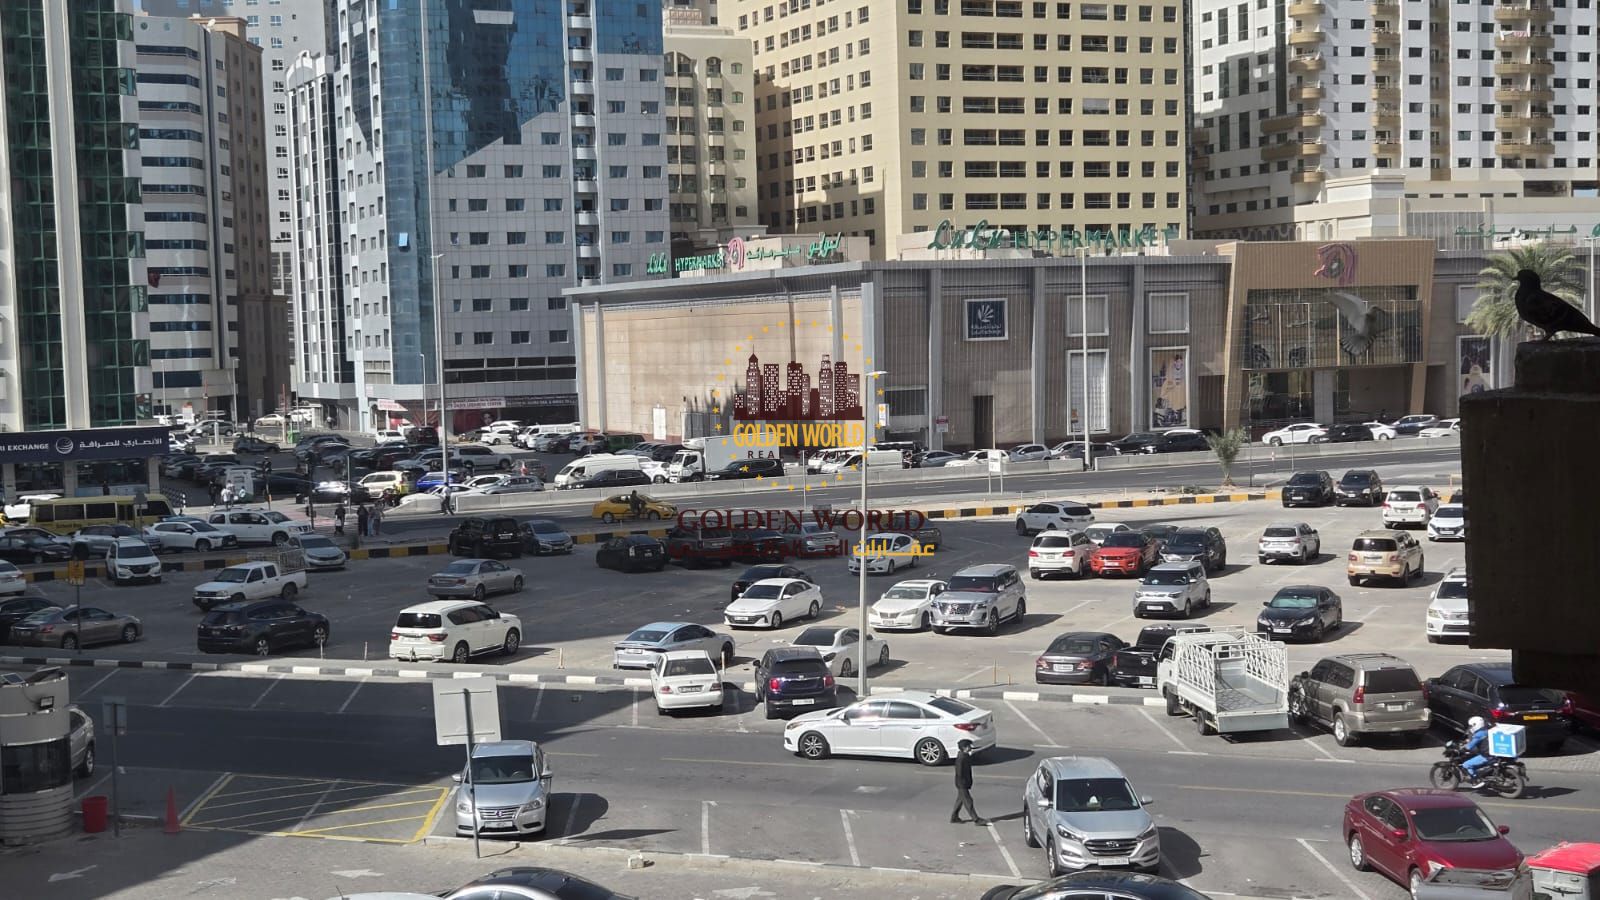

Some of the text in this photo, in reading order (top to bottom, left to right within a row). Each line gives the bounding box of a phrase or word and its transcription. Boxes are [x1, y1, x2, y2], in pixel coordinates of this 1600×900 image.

[1014, 227, 1175, 249] HYPERMARKET
[675, 252, 725, 272] HYPERMARKET
[8, 443, 49, 451] EXCHANGE
